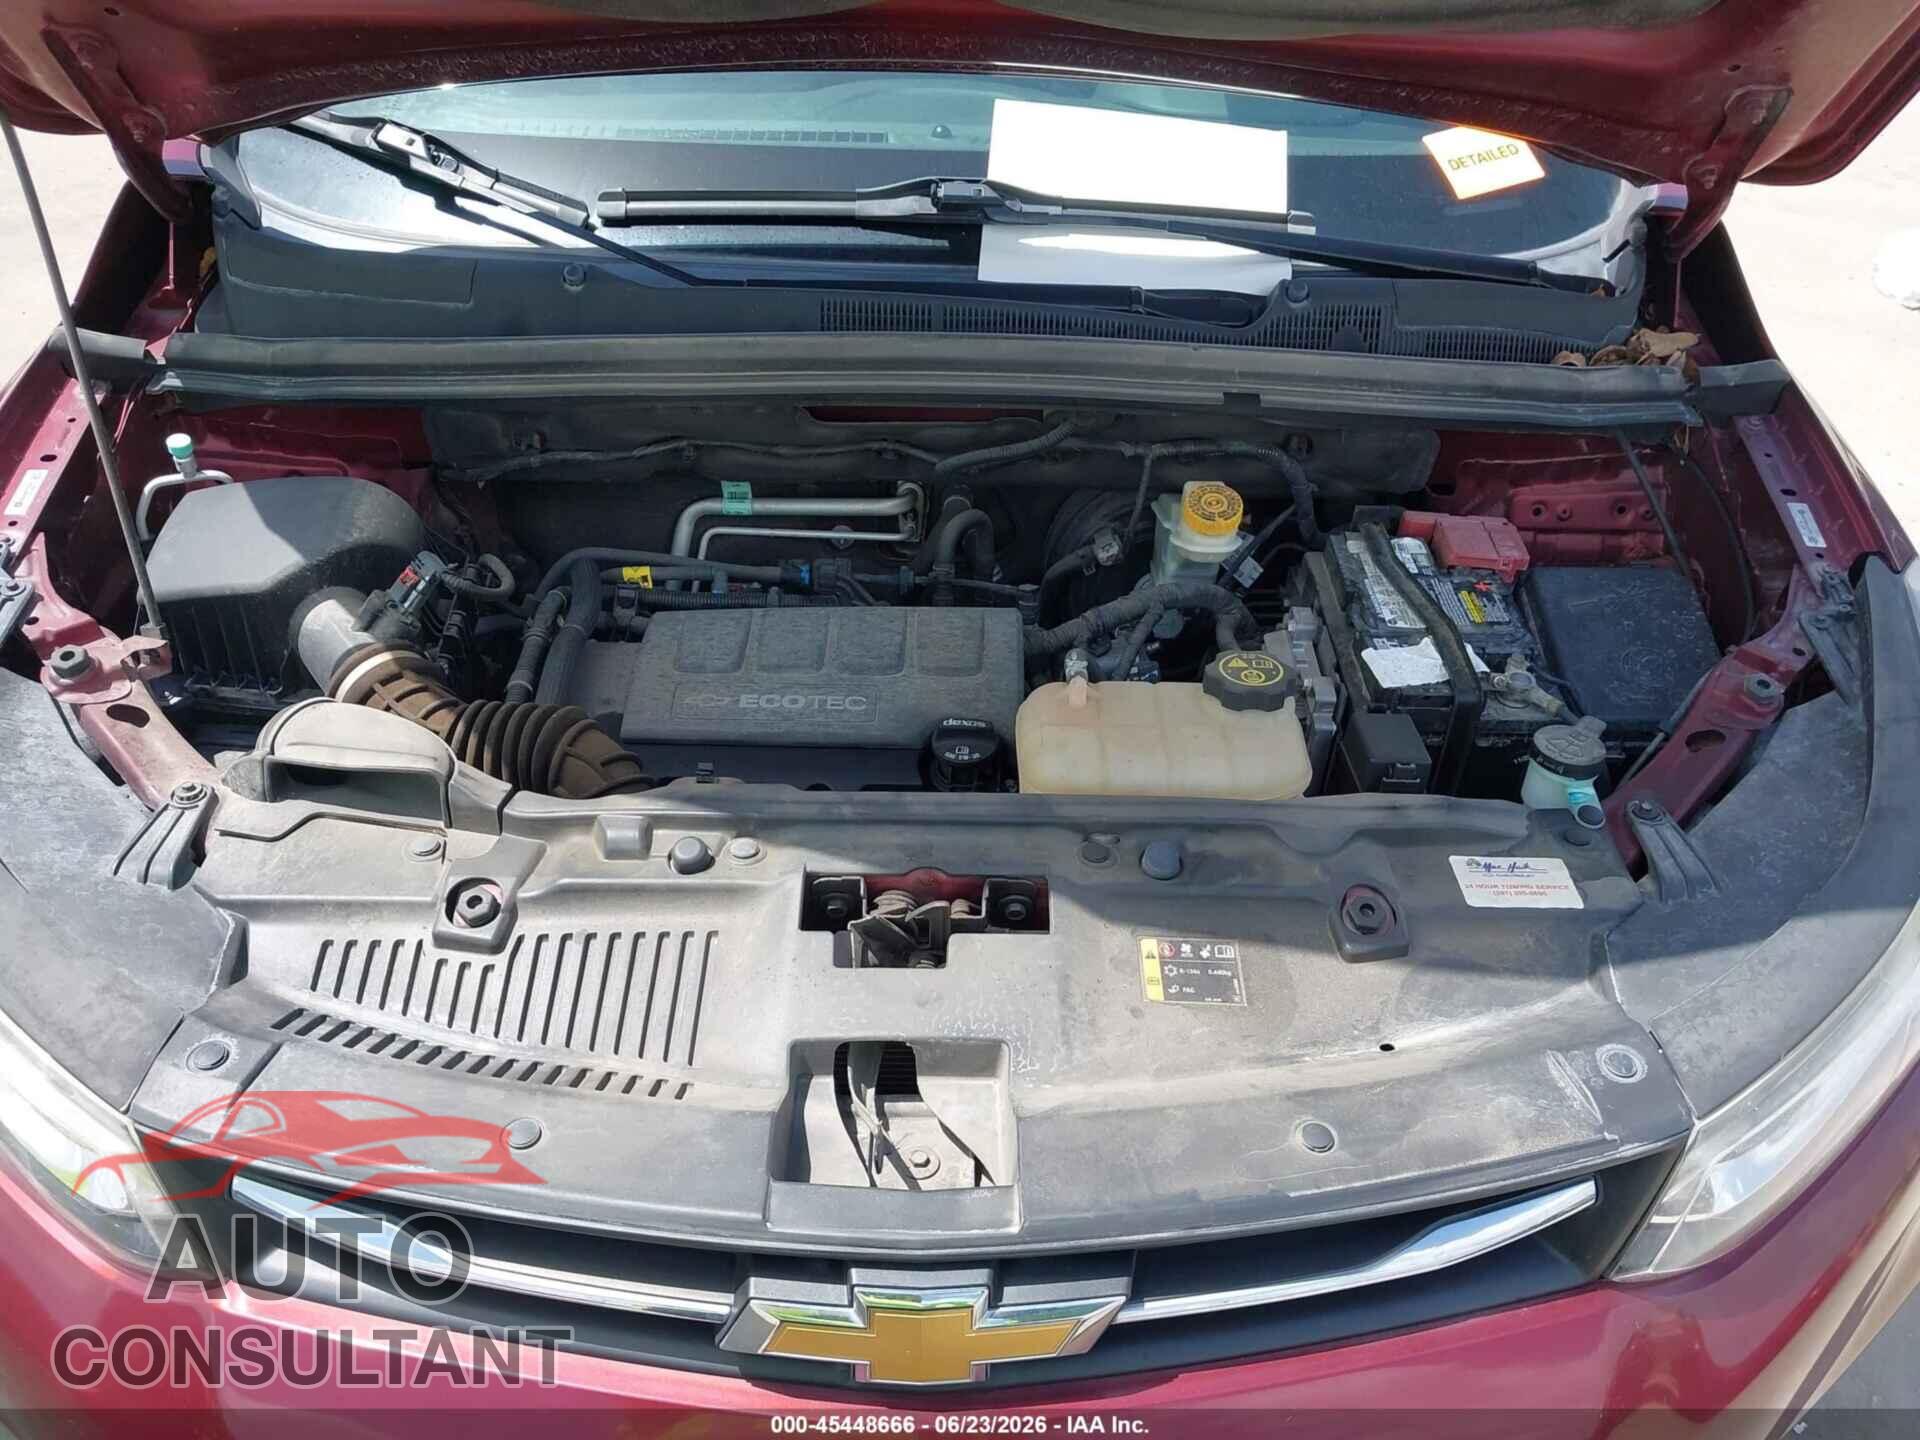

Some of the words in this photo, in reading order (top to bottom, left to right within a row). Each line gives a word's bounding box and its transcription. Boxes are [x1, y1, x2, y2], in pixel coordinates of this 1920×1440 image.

[1448, 144, 1520, 171] DETAILED
[739, 695, 868, 711] ECOTEC
[943, 718, 987, 728] dexos
